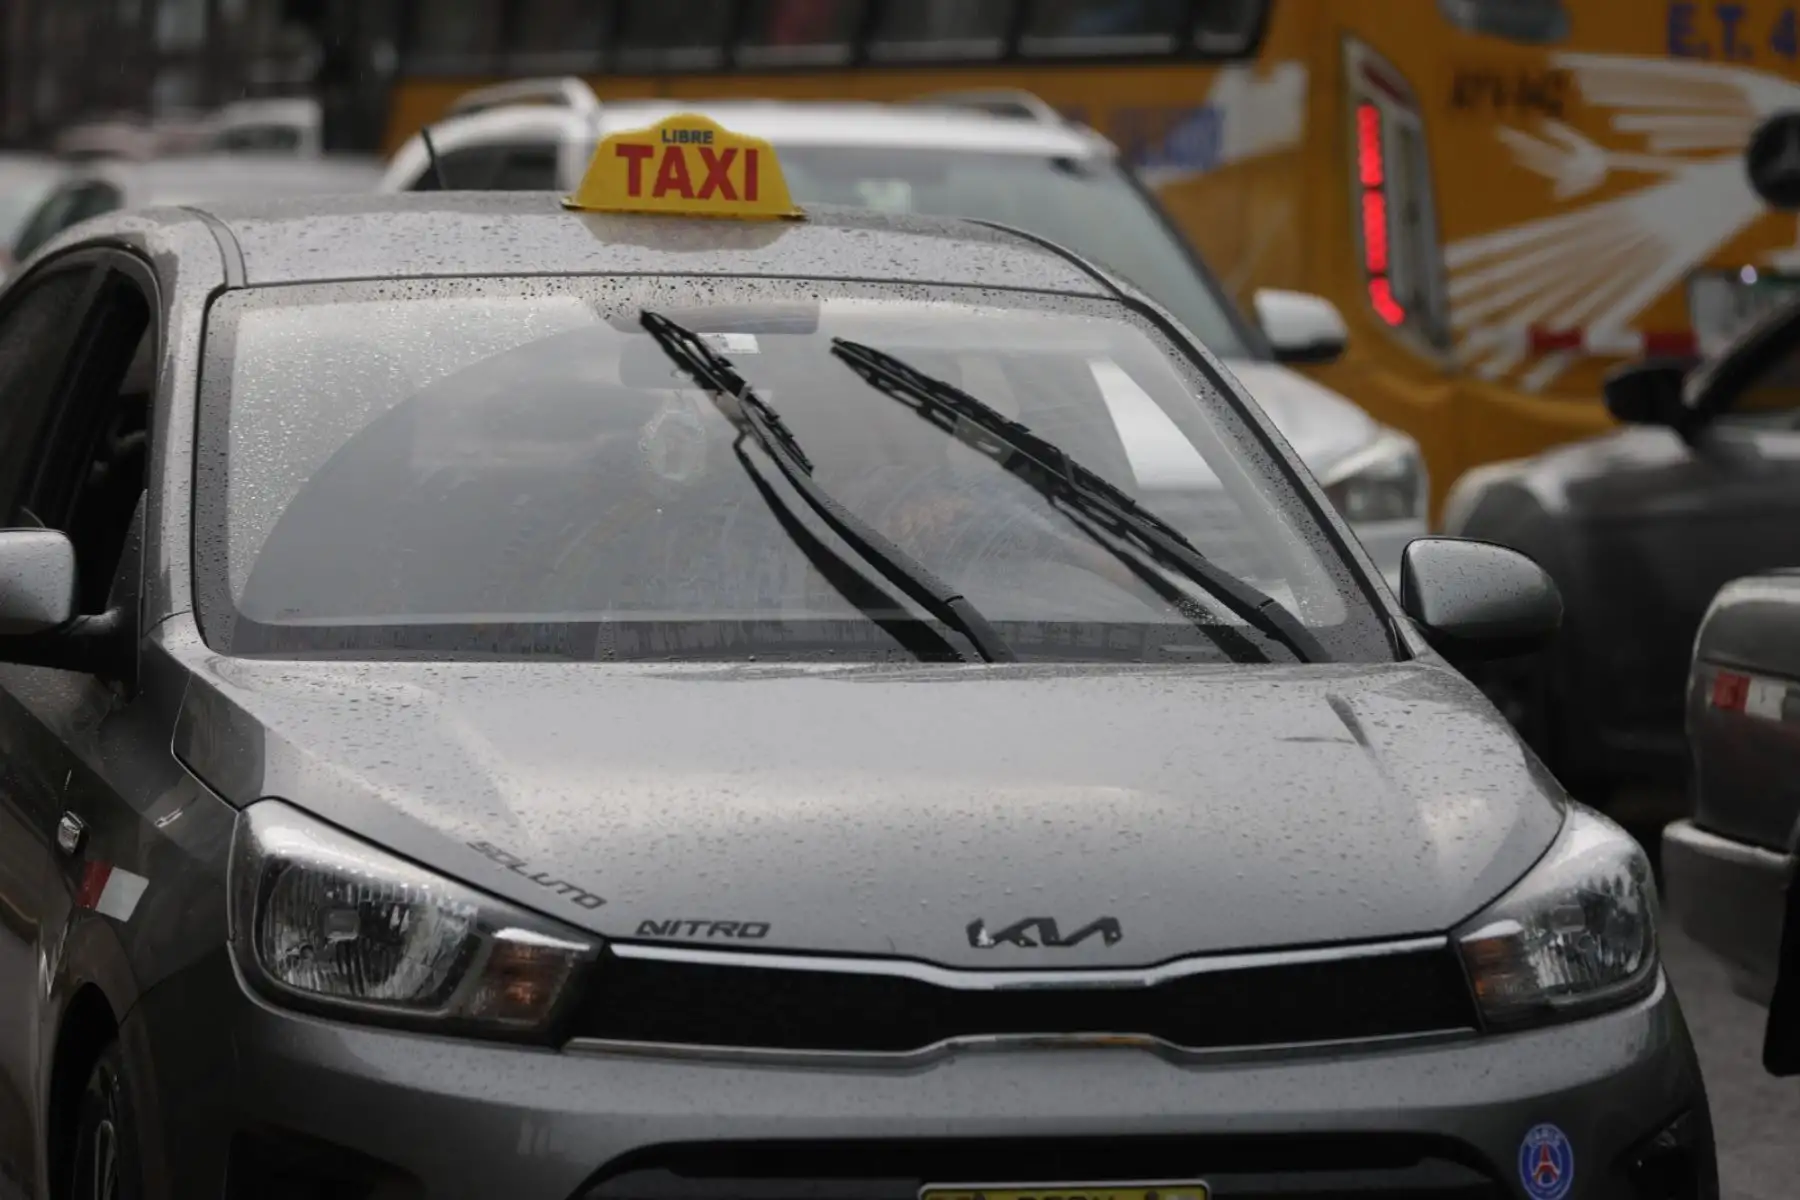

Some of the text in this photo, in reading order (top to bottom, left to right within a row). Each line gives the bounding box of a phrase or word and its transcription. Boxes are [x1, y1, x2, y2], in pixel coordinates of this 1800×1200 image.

[661, 129, 714, 145] LIBRE
[615, 143, 759, 202] TAXI
[465, 841, 607, 910] SOLUTO
[634, 919, 771, 939] NITRO
